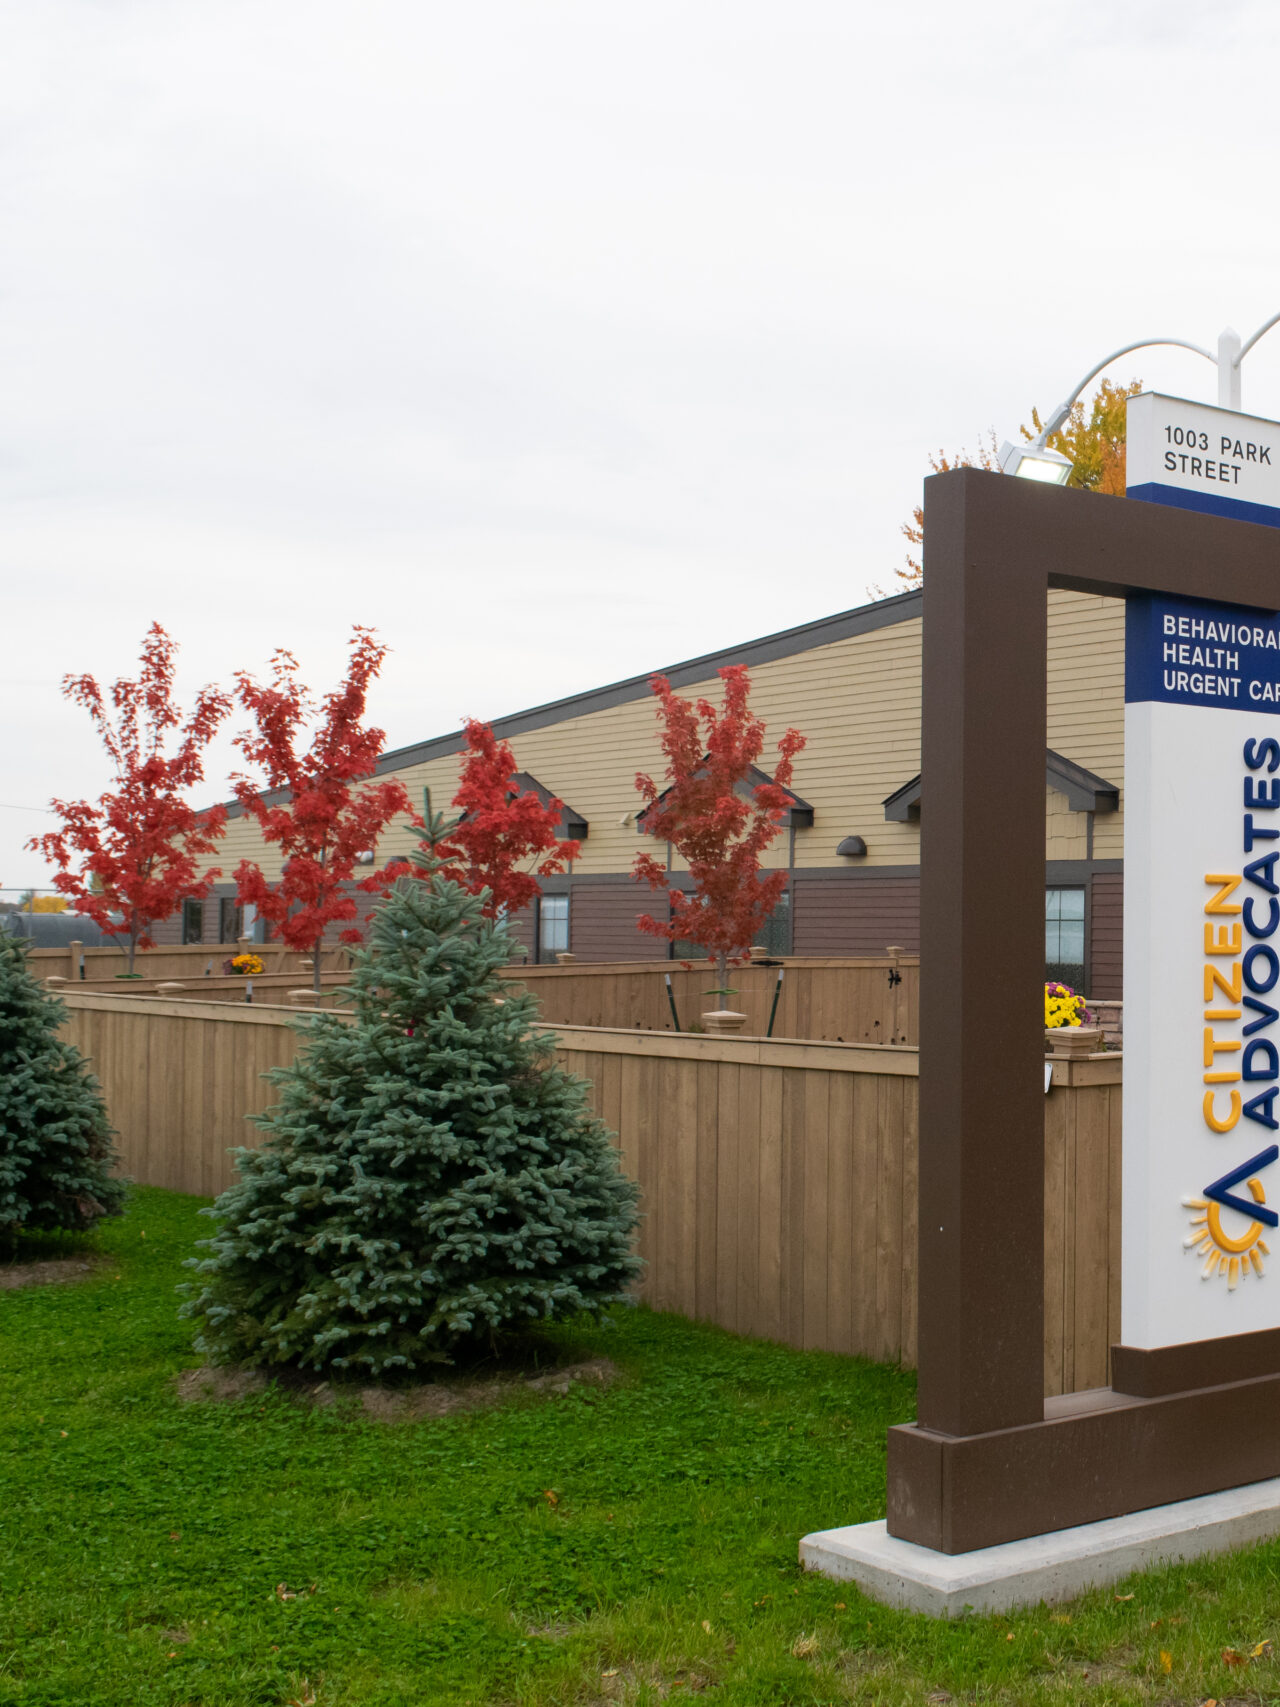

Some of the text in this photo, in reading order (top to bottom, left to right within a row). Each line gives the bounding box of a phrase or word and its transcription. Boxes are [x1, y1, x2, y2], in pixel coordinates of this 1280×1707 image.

[1164, 425, 1272, 465] 1003 PARK
[1164, 451, 1242, 484] STREET
[1163, 642, 1239, 671] HEALTH
[1163, 669, 1242, 698] URGENT
[1242, 737, 1280, 1131] ADVOCATES
[1203, 873, 1243, 1134] CITIZEN
